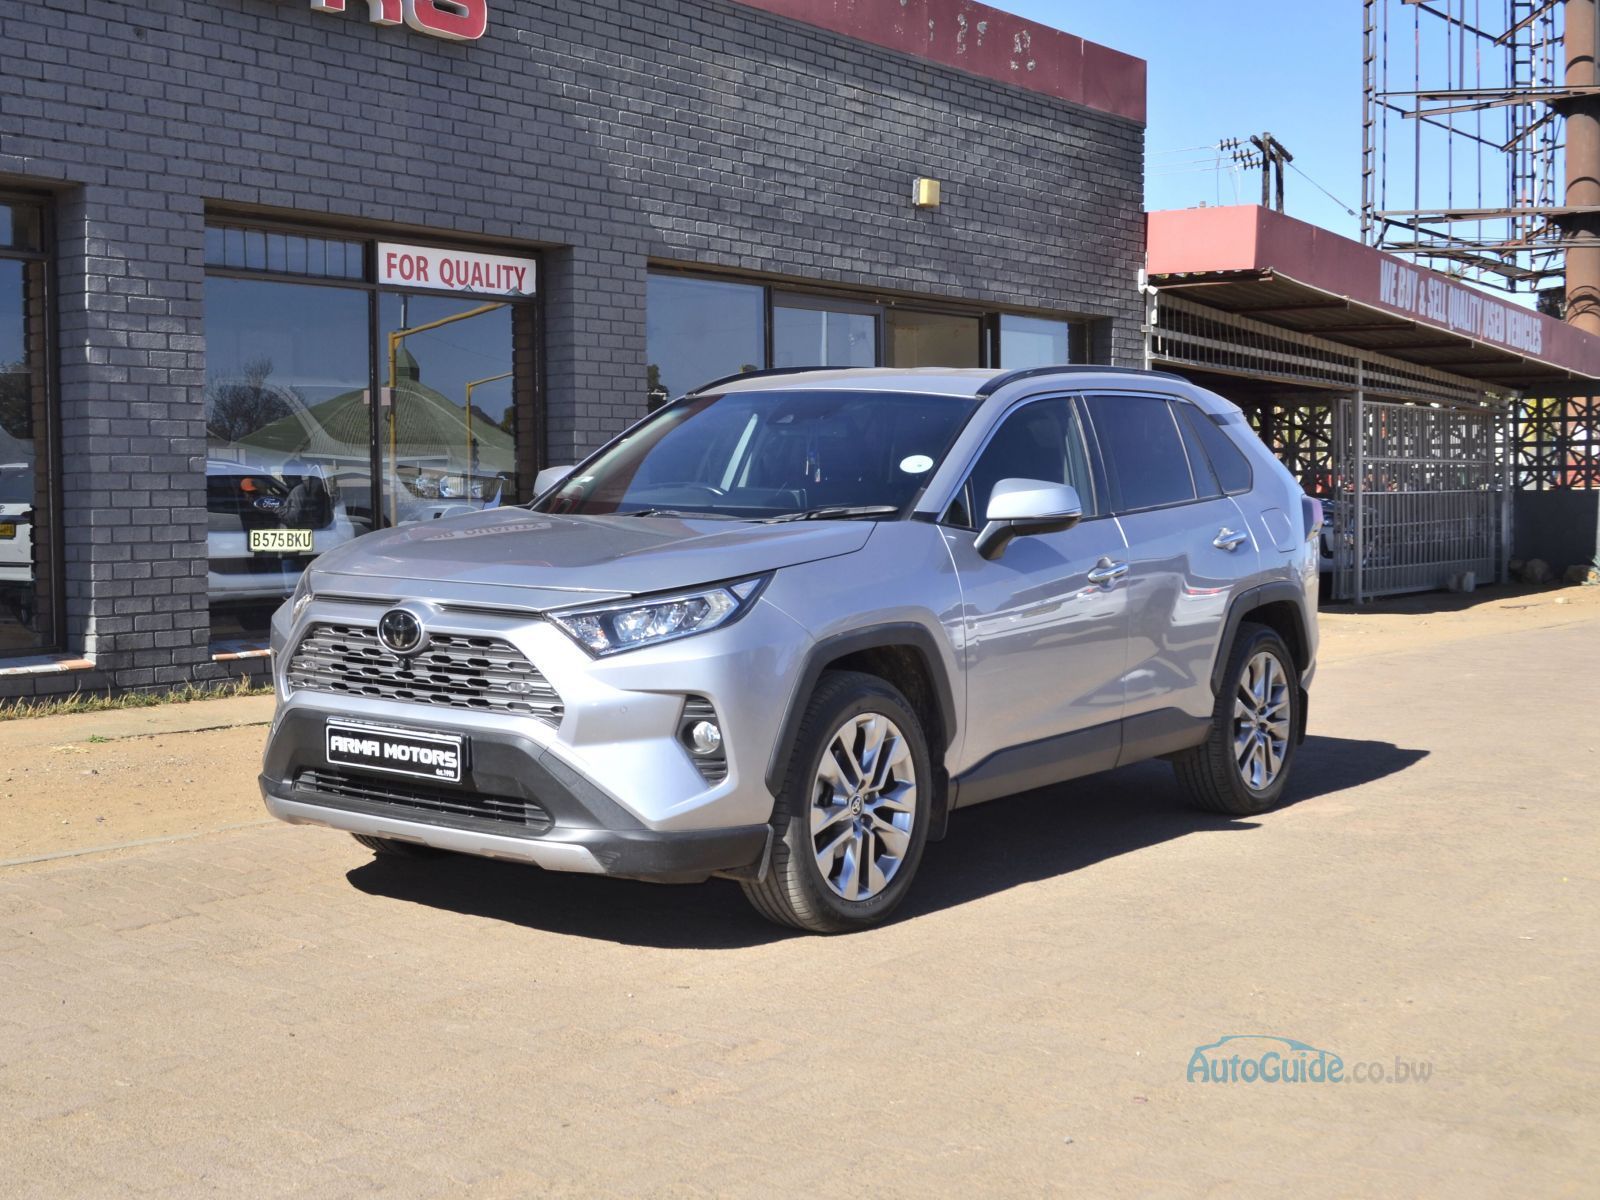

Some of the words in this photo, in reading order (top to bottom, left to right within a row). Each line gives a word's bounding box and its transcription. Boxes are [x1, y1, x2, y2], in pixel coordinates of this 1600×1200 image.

[386, 252, 429, 282] FOR
[439, 258, 526, 291] QUALITY
[1380, 258, 1397, 306] WE
[1397, 265, 1418, 313] BUY
[1418, 280, 1426, 316] &
[1427, 276, 1447, 323] SELL
[1448, 286, 1482, 336] QUALITY
[1482, 299, 1505, 342] USED
[1505, 307, 1542, 356] VEHICLES
[330, 735, 380, 757] ARMA
[383, 742, 458, 768] MOTORS
